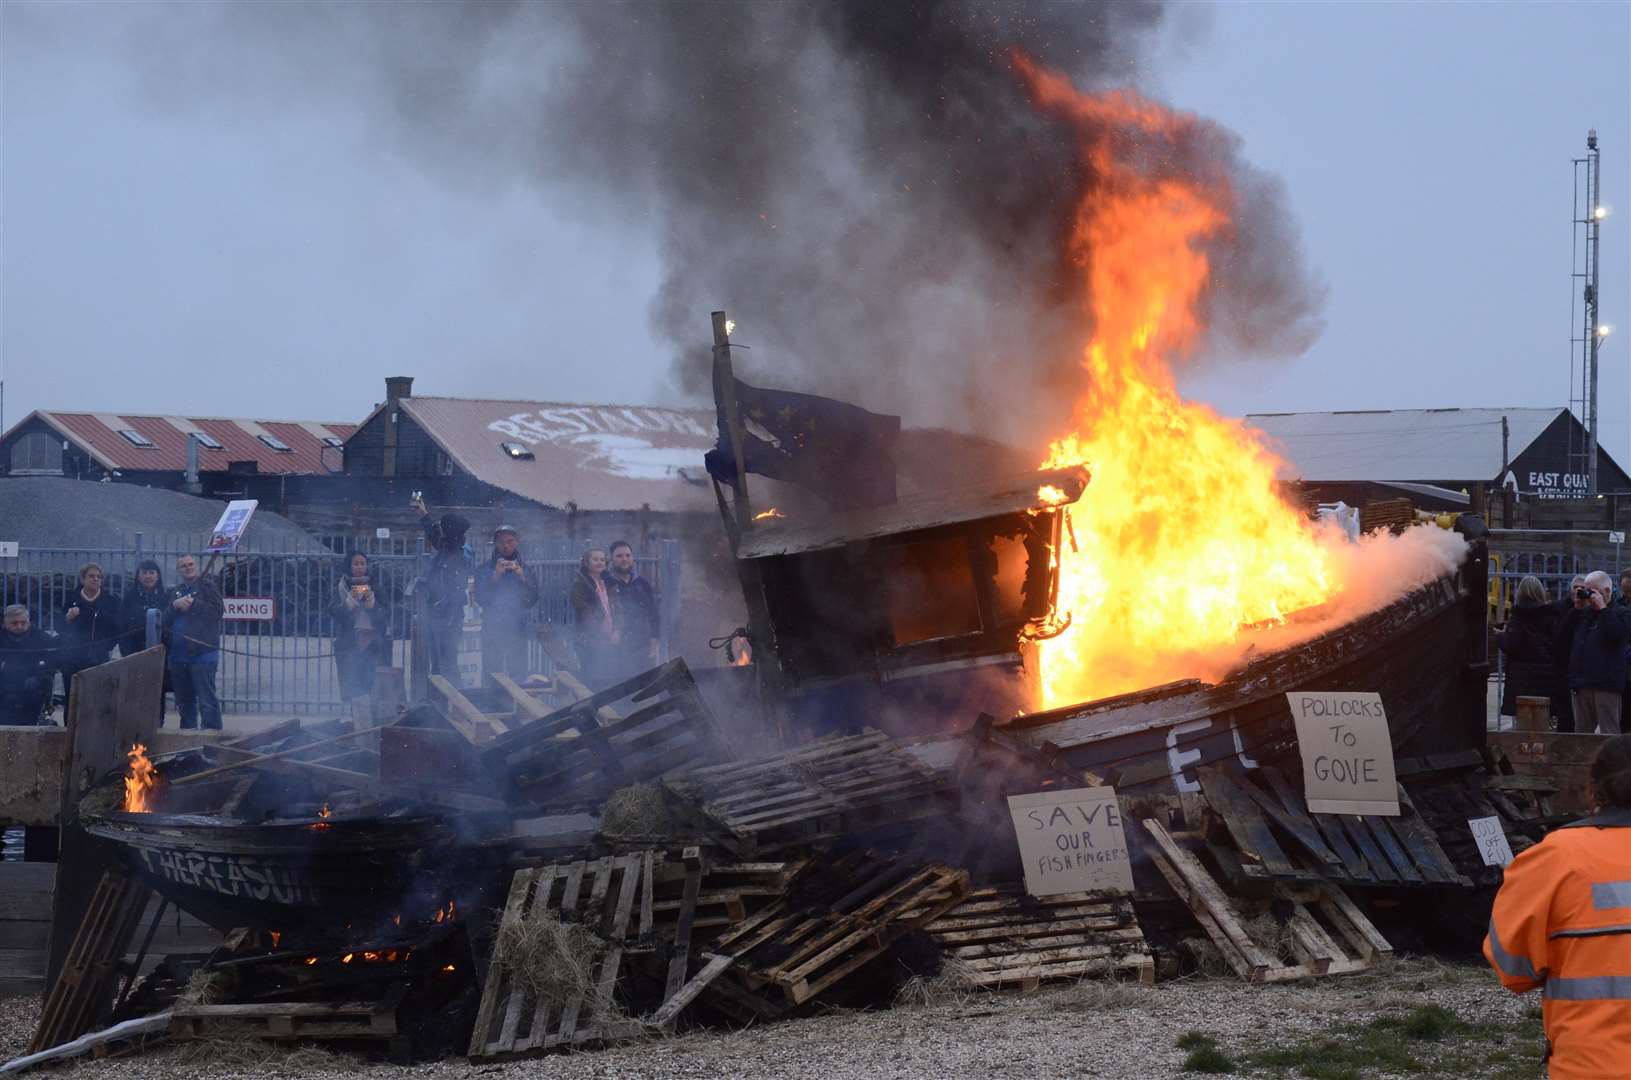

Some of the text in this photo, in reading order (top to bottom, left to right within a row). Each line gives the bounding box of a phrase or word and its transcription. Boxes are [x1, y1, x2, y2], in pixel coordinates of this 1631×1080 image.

[1529, 471, 1591, 489] EAST QUA
[1301, 697, 1383, 718] POLLOCKS
[1314, 755, 1379, 786] GOVE
[1028, 803, 1120, 830] SAVE
[1055, 831, 1095, 851] OUR
[1039, 847, 1130, 876] FISH FINGERS
